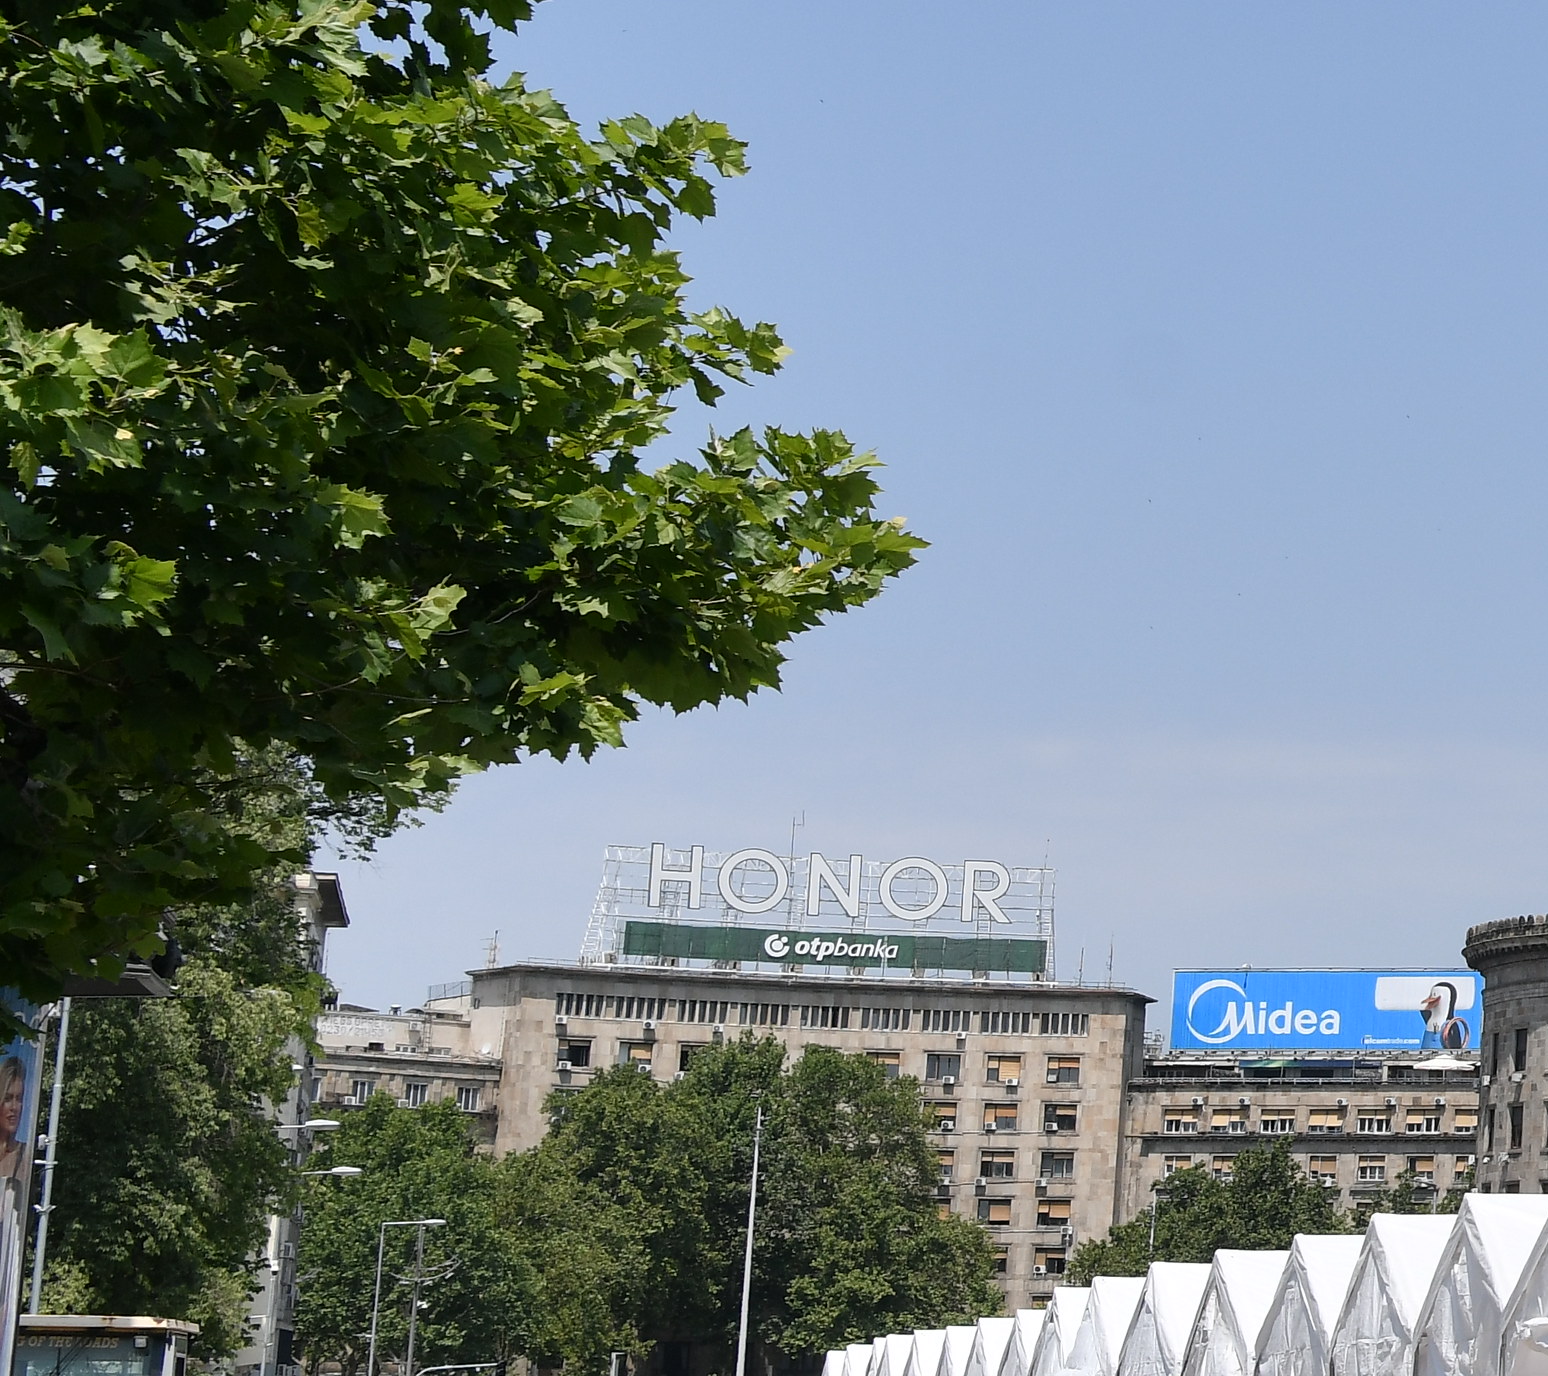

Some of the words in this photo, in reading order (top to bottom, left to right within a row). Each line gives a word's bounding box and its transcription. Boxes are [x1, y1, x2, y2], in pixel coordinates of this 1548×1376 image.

[647, 842, 1012, 924] HONOR
[795, 938, 899, 961] otpbanka
[1208, 1000, 1341, 1035] Midea
[28, 1335, 46, 1347] OF
